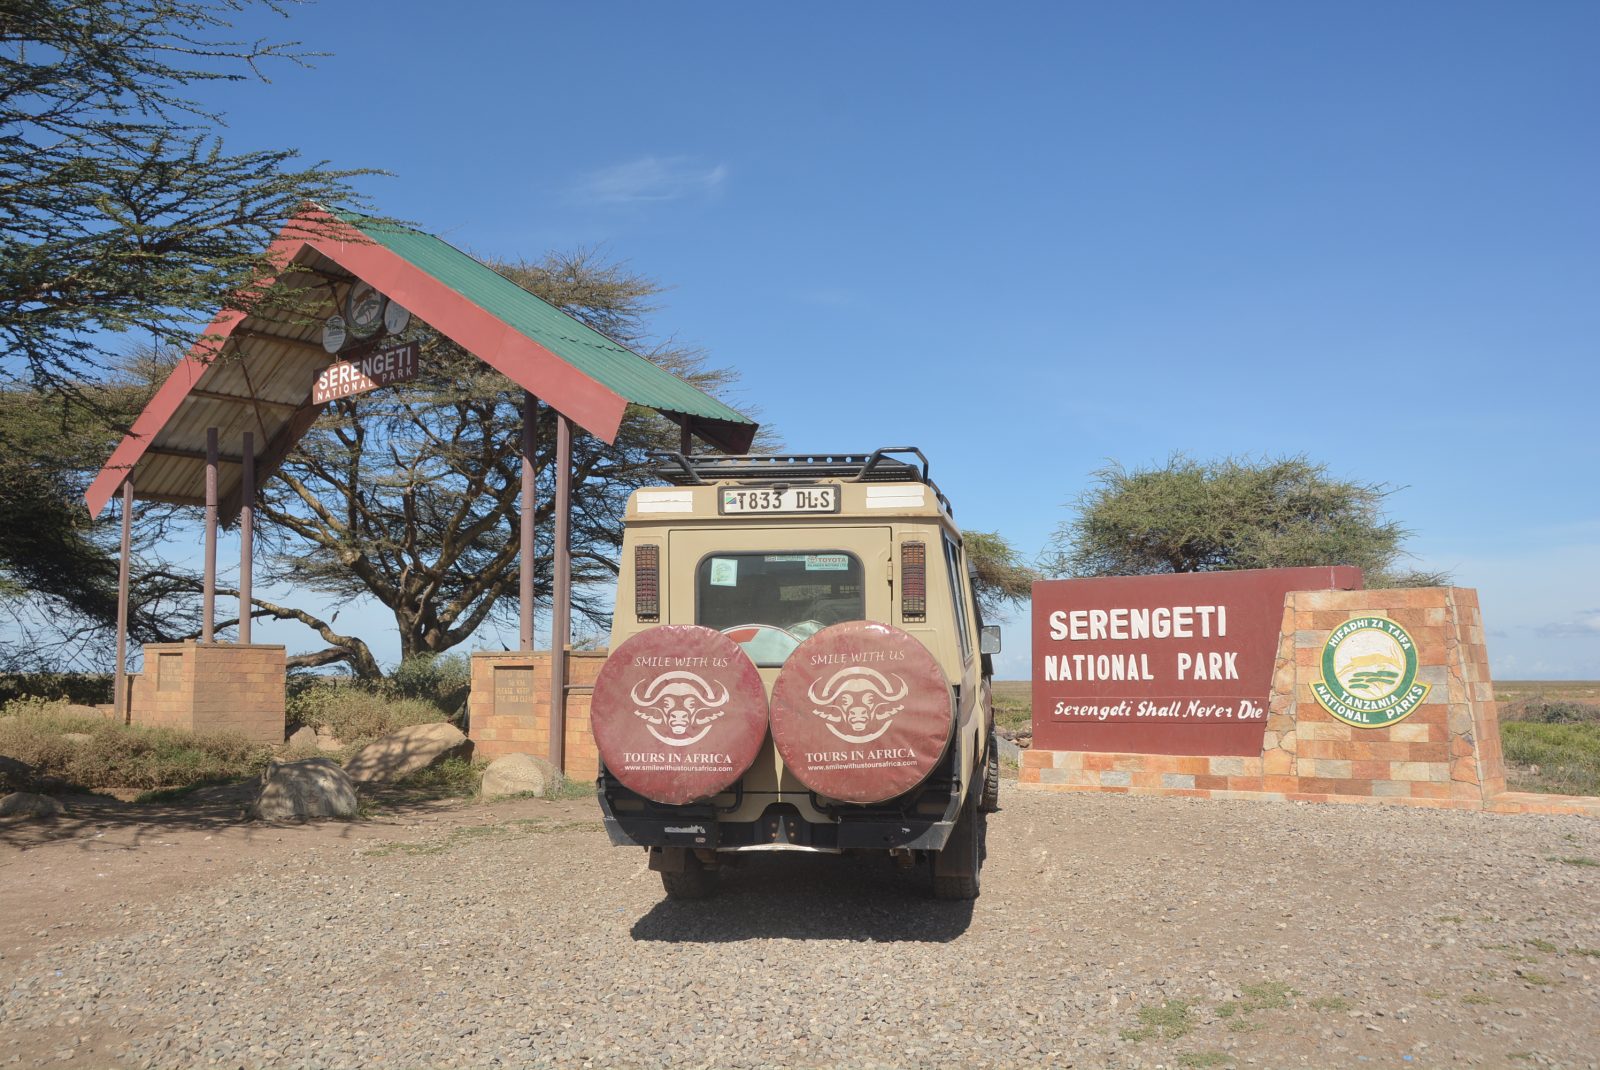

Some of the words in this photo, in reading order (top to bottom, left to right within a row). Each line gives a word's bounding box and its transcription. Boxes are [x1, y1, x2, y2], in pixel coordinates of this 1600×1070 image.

[319, 346, 411, 390] SERENGETI
[317, 379, 373, 401] NATIONAL
[382, 366, 413, 383] PARK
[737, 491, 782, 510] T833
[796, 491, 830, 509] DLS
[1049, 605, 1227, 641] SERENGETI
[1328, 619, 1368, 648] HIFADHI
[1371, 619, 1384, 629] ZA
[1387, 624, 1411, 650] TAIFA
[634, 656, 671, 667] SMILE
[675, 657, 708, 667] WITH
[712, 657, 729, 668] US
[810, 653, 848, 666] SMILE
[851, 650, 885, 663] WITH
[889, 649, 905, 660] US
[1044, 653, 1154, 682] NATIONAL
[1177, 651, 1239, 681] PARK
[1054, 700, 1133, 720] Serengeti
[1136, 700, 1182, 718] Shall
[1182, 699, 1232, 718] Never
[1237, 699, 1264, 720] Die
[1317, 685, 1370, 723] NATIONAL
[1385, 686, 1423, 719] PARKS
[1340, 690, 1399, 710] TANZANIA
[623, 752, 665, 763] TOURS
[668, 752, 681, 763] IN
[684, 753, 732, 764] AFRICA
[805, 751, 848, 763] TOURS
[851, 750, 864, 761] IN
[867, 748, 916, 760] AFRICA
[808, 759, 918, 771] www.smilewithustoursafrica.com
[624, 764, 733, 772] www.smilewithustoursafrica.com
